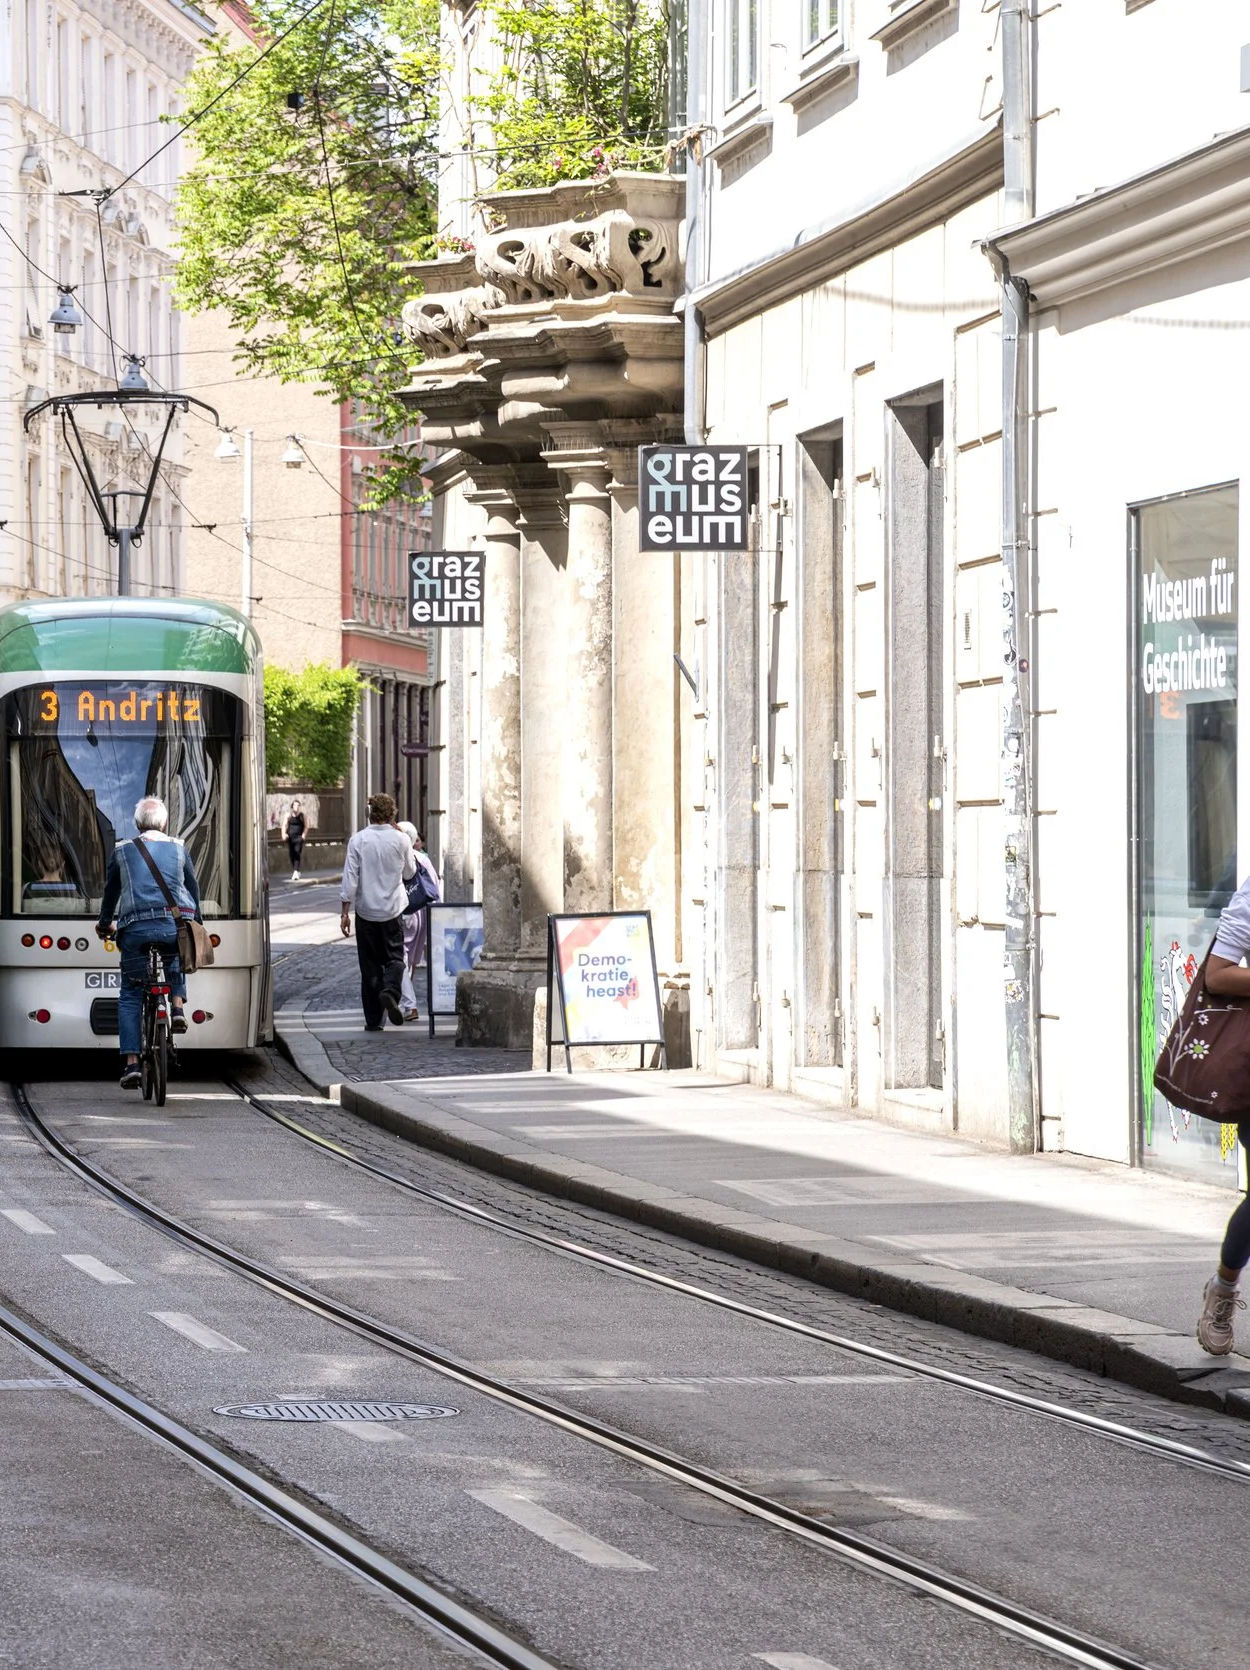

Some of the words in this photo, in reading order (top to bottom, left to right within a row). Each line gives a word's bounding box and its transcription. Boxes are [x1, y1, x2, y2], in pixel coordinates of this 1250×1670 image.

[647, 452, 742, 482] graz
[648, 483, 743, 513] mus
[647, 514, 742, 544] eum
[412, 556, 481, 578] graz
[413, 578, 481, 600] mus
[1143, 571, 1207, 625] Museum
[1210, 556, 1235, 616] für
[412, 601, 481, 622] eum
[1142, 632, 1227, 694] Geschichte
[40, 690, 58, 721] 3
[78, 690, 200, 721] Andritz
[578, 953, 632, 967] Demo-
[86, 973, 121, 988] GR
[581, 968, 633, 983] kratie,
[586, 983, 637, 998] heast!
